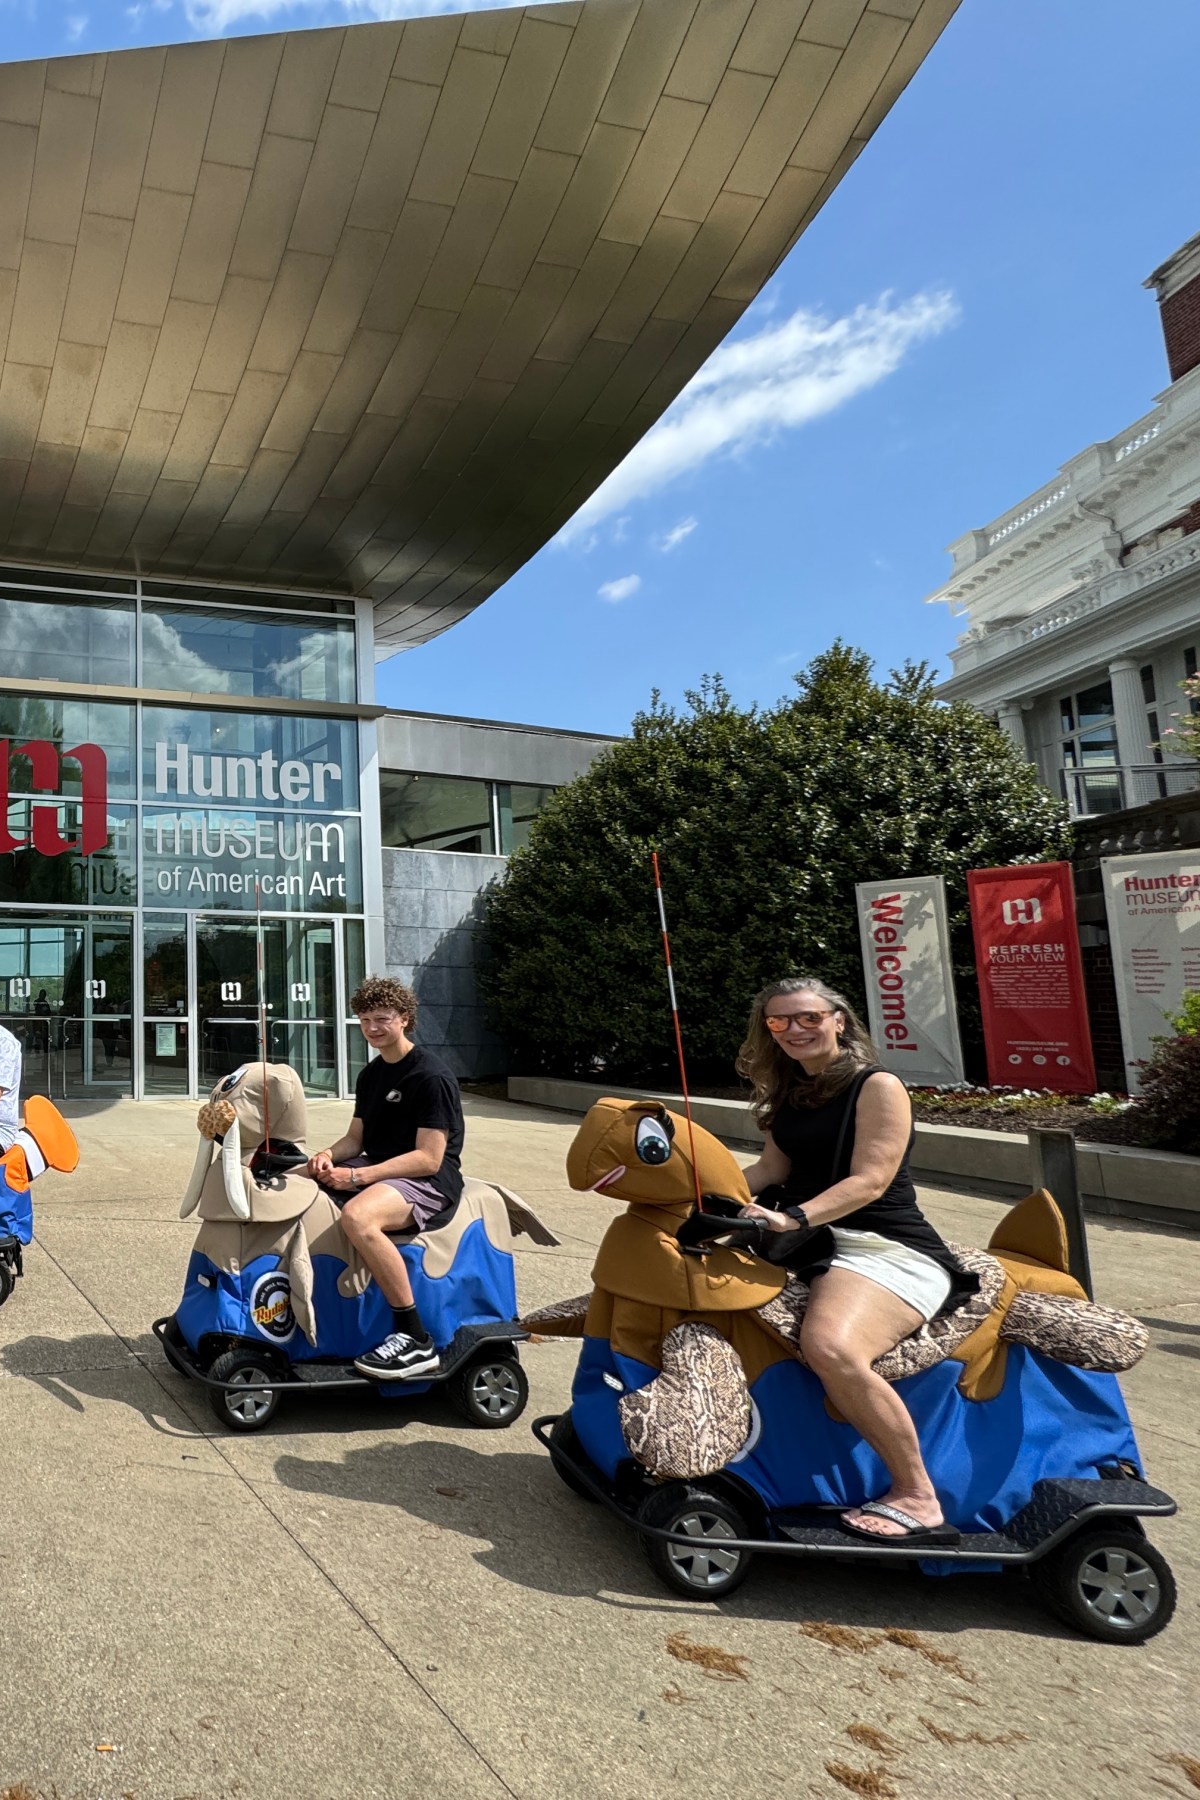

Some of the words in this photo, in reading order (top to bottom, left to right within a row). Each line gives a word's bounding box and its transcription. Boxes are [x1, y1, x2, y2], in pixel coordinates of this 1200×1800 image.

[155, 742, 341, 802] Hunter
[157, 865, 182, 892] of
[187, 866, 303, 896] American
[308, 871, 346, 898] Art
[1124, 874, 1200, 891] Hunter
[1128, 908, 1138, 916] of
[1141, 905, 1191, 915] American
[989, 944, 1065, 954] REFRESH
[989, 954, 1025, 963] YOUR
[1030, 953, 1065, 963] VIEW
[871, 893, 918, 1051] Welcome!
